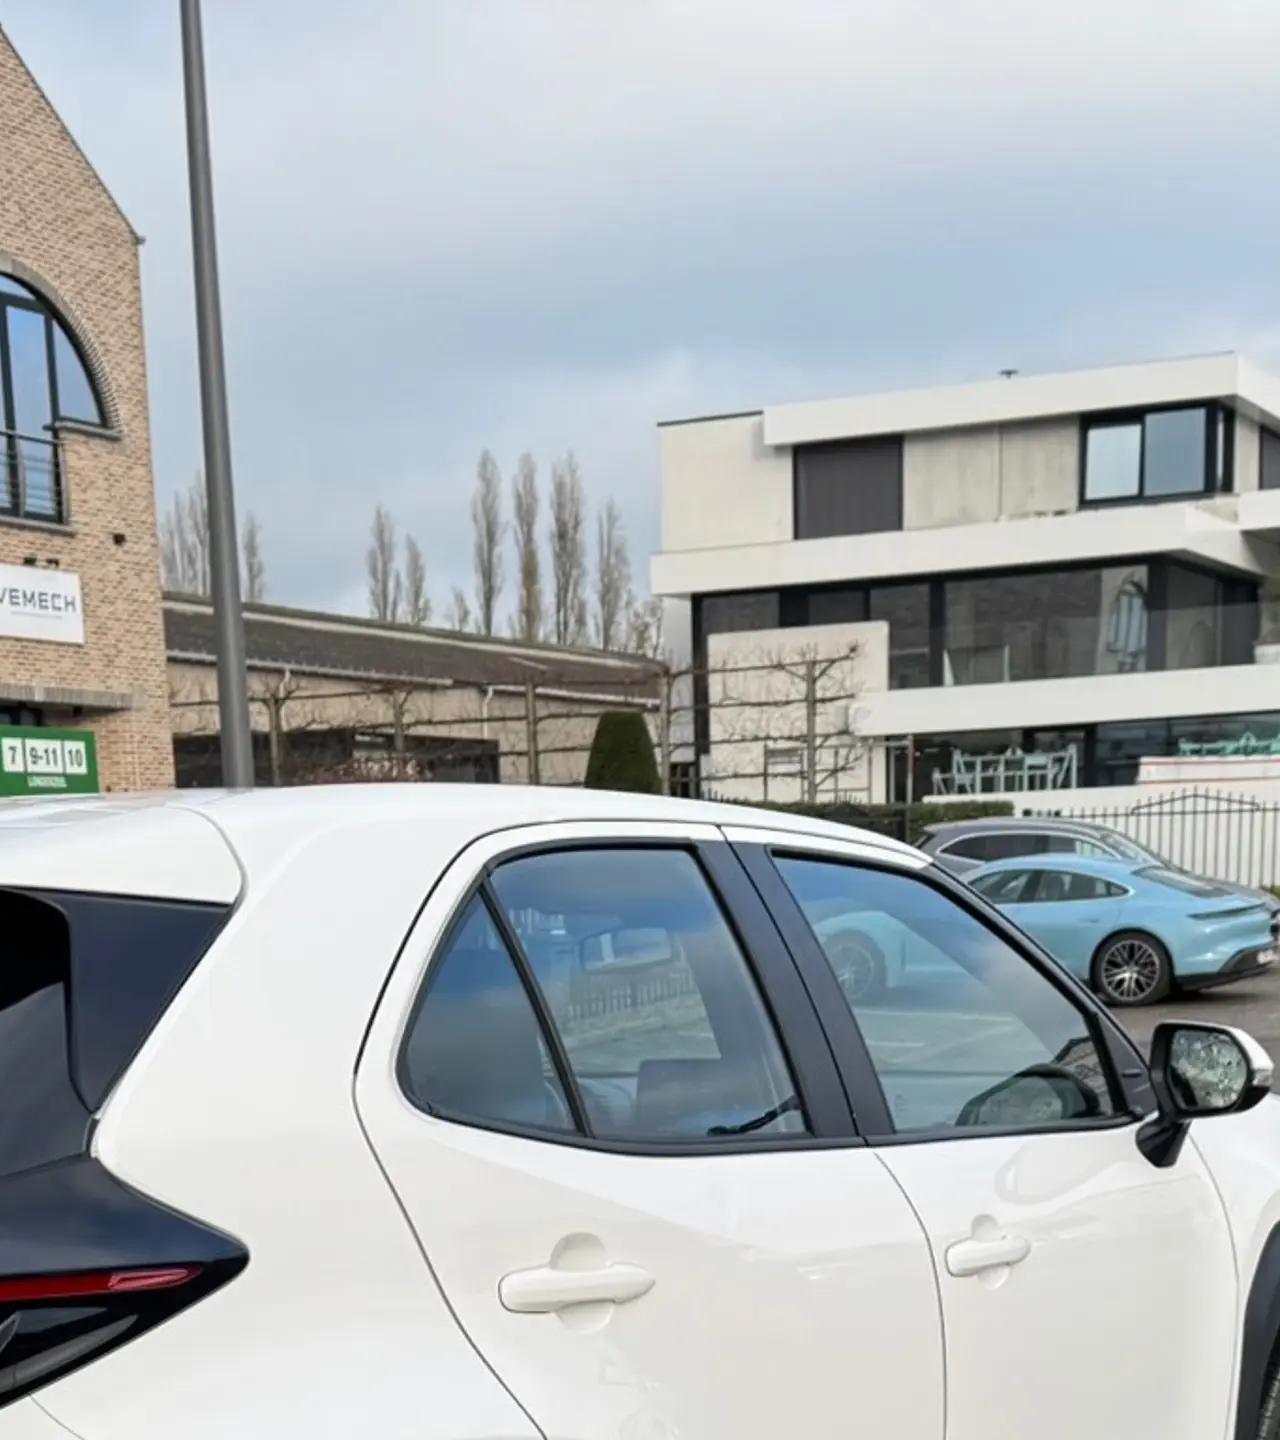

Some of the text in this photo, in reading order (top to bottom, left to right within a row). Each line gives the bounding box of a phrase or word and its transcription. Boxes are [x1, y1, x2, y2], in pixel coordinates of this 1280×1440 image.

[7, 745, 83, 768] 7 9-11 10
